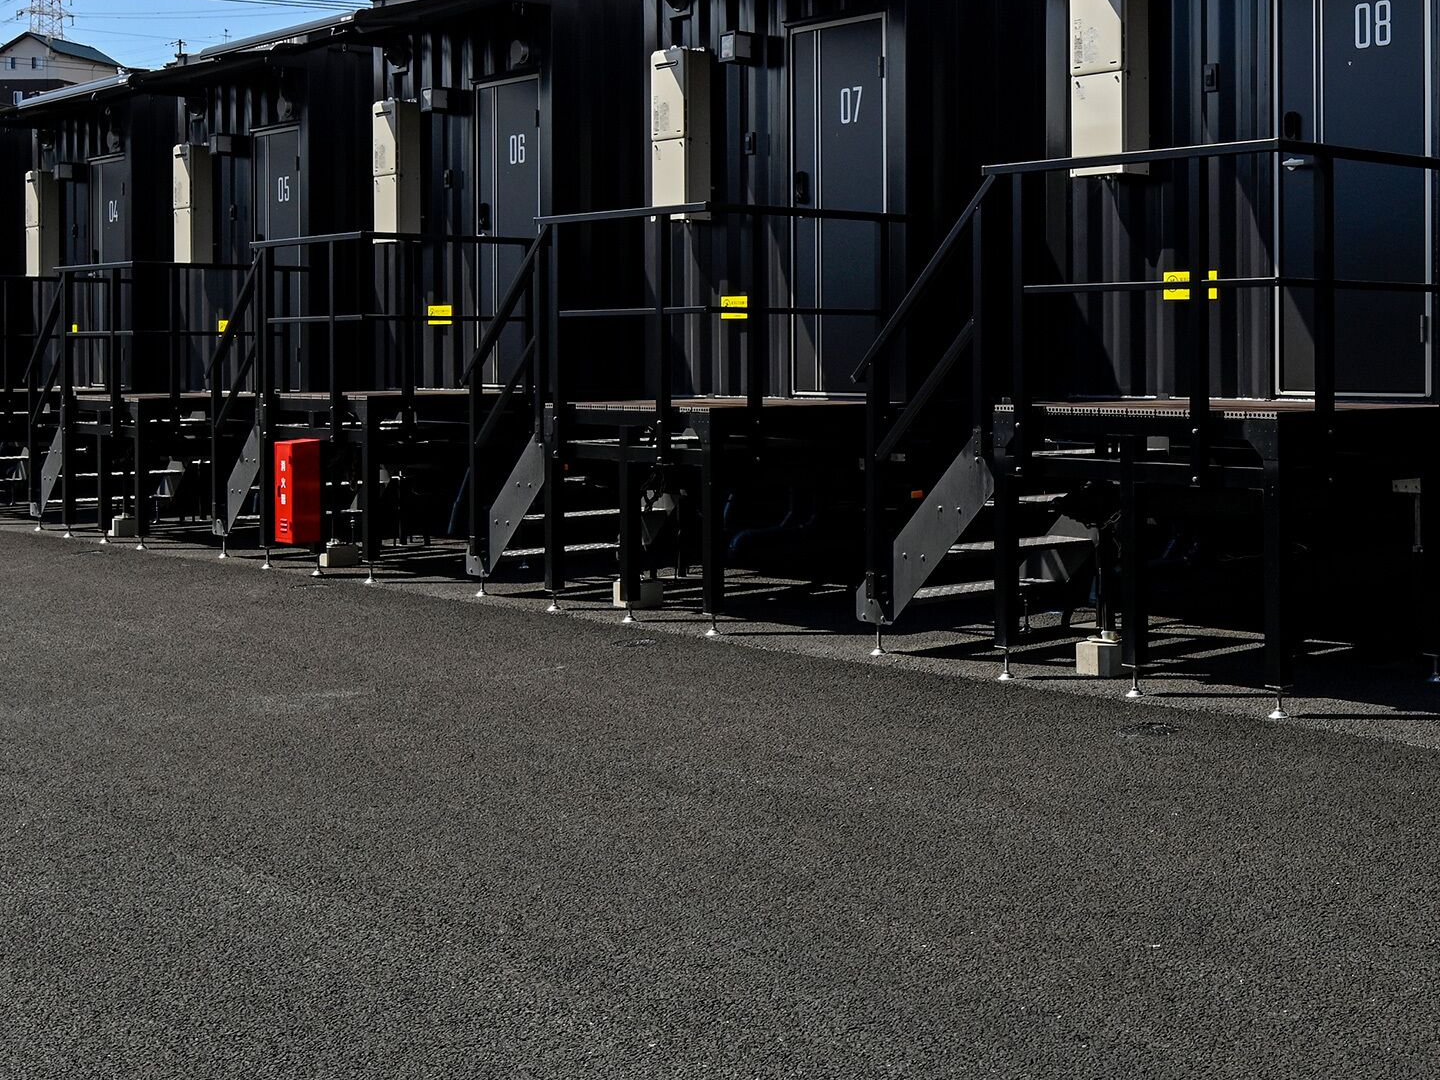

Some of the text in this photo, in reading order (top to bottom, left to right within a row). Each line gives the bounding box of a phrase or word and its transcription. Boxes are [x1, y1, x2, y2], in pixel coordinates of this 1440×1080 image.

[1354, 0, 1392, 49] 08
[840, 85, 863, 124] 07
[509, 133, 526, 165] 06
[277, 175, 290, 202] 05
[108, 199, 119, 223] 04
